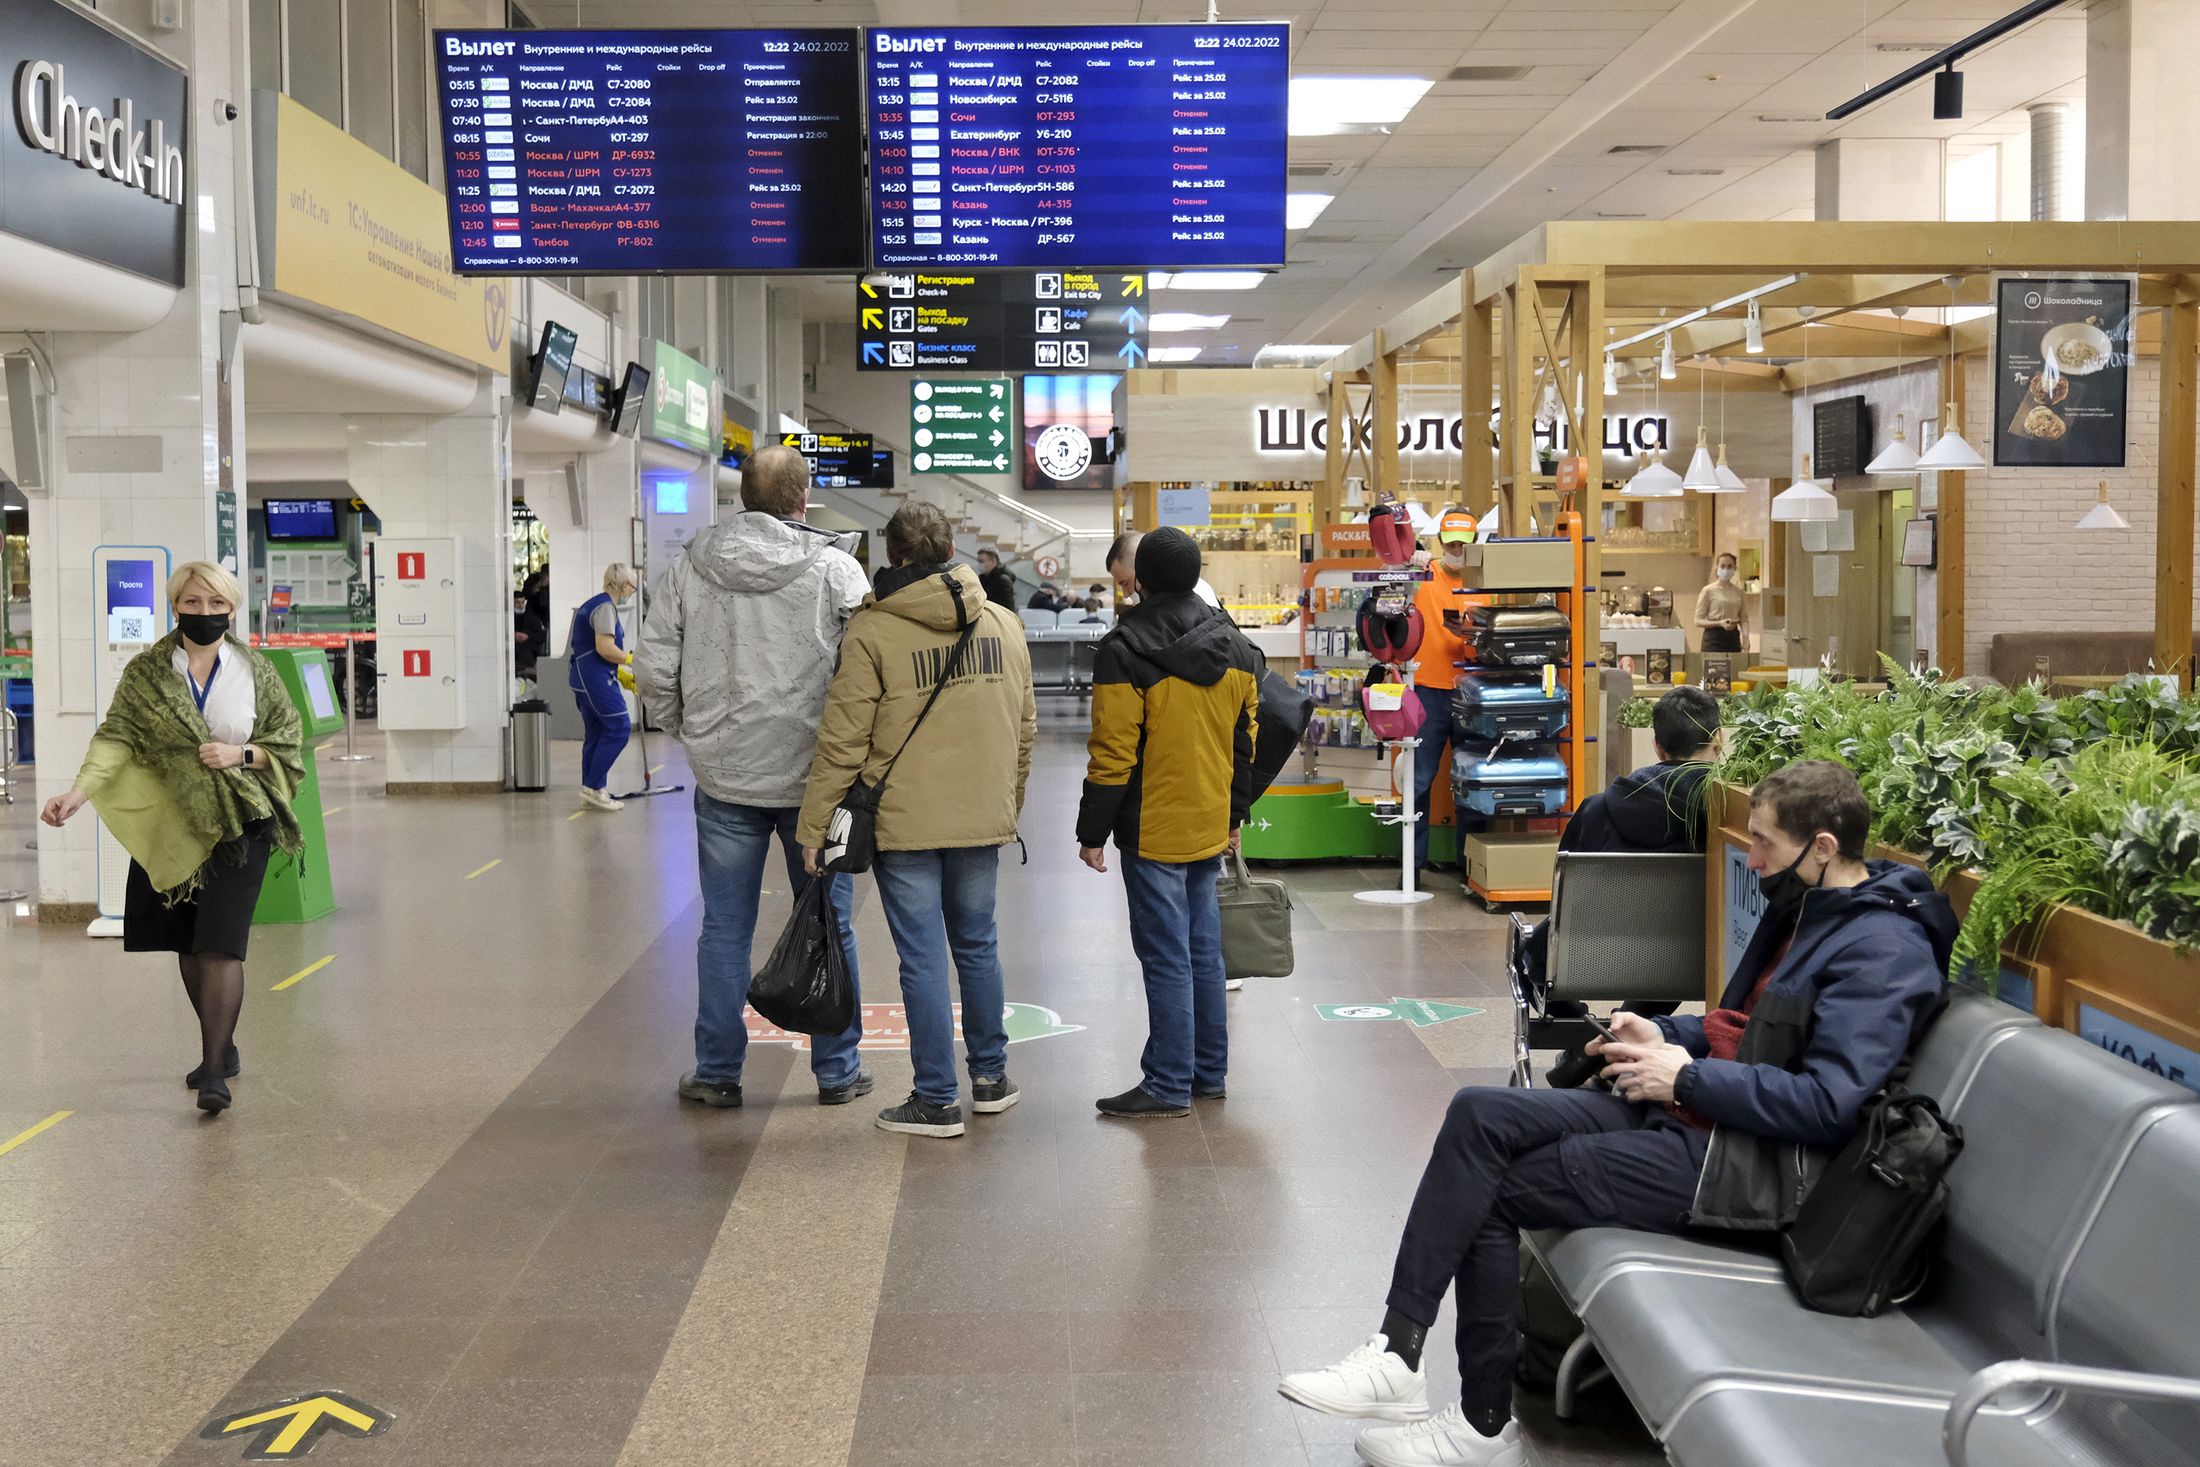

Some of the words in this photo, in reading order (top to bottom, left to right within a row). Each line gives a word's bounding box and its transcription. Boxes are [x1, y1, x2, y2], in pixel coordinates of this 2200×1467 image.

[446, 38, 515, 55] Вылет
[877, 34, 946, 52] Вылет
[955, 41, 1015, 52] Внутренние
[1026, 42, 1109, 51] международные
[1111, 40, 1142, 50] рейсы
[1194, 38, 1220, 47] 12:22
[1223, 37, 1279, 47] 24.02.2022
[524, 45, 584, 55] Внутренние
[596, 45, 678, 55] международные
[681, 44, 712, 54] рейсы
[764, 43, 789, 52] 12:22
[793, 43, 849, 52] 24.02.2022
[521, 80, 559, 89] Москва
[569, 80, 594, 90] ДМД
[608, 80, 651, 89] С7-2080
[745, 79, 800, 87] Отправляется
[877, 77, 900, 86] 13:15
[949, 77, 988, 86] Москва
[997, 76, 1022, 87] ДМД
[1036, 76, 1078, 85] С7-2082
[450, 81, 475, 90] 05:15
[451, 98, 479, 107] 07:30
[522, 98, 560, 107] Москва
[570, 98, 595, 108] ДМД
[609, 98, 651, 107] С7-2084
[878, 95, 903, 104] 13:30
[950, 95, 1017, 105] Новосибирск
[1036, 94, 1073, 103] С7-5116
[452, 116, 481, 125] 07:40
[609, 115, 648, 124] А4-403
[746, 114, 796, 122] Регистрация
[879, 113, 902, 122] 13:35
[951, 113, 975, 121] Сочи
[1037, 112, 1075, 120] ЮТ-293
[20, 60, 183, 205] Check-In
[879, 131, 904, 139] 13:45
[951, 130, 1021, 141] Екатеринбург
[1037, 129, 1071, 138] У6-210
[1204, 127, 1225, 135] 25.02
[454, 134, 480, 143] 08:15
[525, 134, 550, 142] Сочи
[611, 133, 649, 142] ЮТ-297
[747, 132, 797, 140] Регистрация
[456, 152, 480, 160] 10:55
[527, 152, 564, 160] Москва
[574, 151, 599, 159] ШРМ
[612, 151, 655, 160] ДР-6932
[880, 148, 907, 157] 14:00
[952, 148, 989, 156] Москва
[999, 148, 1020, 156] ВНК
[1037, 147, 1075, 156] ЮТ-576
[457, 169, 479, 178] 11:20
[528, 169, 565, 177] Москва
[575, 169, 600, 177] ШРМ
[613, 168, 651, 177] СУ-1273
[881, 166, 904, 174] 14:10
[952, 166, 989, 174] Москва
[999, 165, 1024, 174] ШРМ
[1037, 165, 1075, 173] СУ-1103
[881, 183, 906, 192] 14:20
[952, 183, 1038, 193] Санкт-Петербург
[1173, 180, 1191, 188] Рейс
[458, 186, 480, 195] 11:25
[529, 186, 566, 195] Москва
[576, 186, 601, 196] ДМД
[614, 186, 655, 194] С7-2072
[460, 204, 485, 212] 12:00
[531, 204, 558, 213] Воды
[882, 201, 907, 209] 14:30
[953, 201, 988, 209] Казань
[1038, 200, 1072, 208] А4-315
[461, 221, 484, 230] 12:10
[617, 220, 659, 229] ФВ-6316
[882, 218, 904, 227] 15:15
[953, 218, 982, 228] Курск
[992, 218, 1029, 226] Москва
[1036, 217, 1072, 226] РГ-396
[463, 238, 486, 247] 12:45
[533, 238, 569, 246] Тамбов
[618, 237, 653, 246] РГ-802
[883, 235, 906, 244] 15:25
[953, 235, 989, 243] Казань
[1038, 234, 1075, 244] ДР-567
[917, 275, 975, 286] Регистрация
[1064, 273, 1094, 283] Выход
[1072, 283, 1100, 291] город
[917, 288, 948, 296] Check-in
[1087, 292, 1102, 301] City
[2043, 297, 2102, 306] Шоколадница
[918, 307, 947, 317] Выход
[1064, 309, 1088, 319] Кафе
[931, 317, 968, 326] посадку
[1064, 322, 1081, 330] Cafe
[917, 325, 938, 333] Gates
[918, 343, 949, 351] Бизнес
[951, 344, 976, 352] класс
[918, 356, 948, 364] Business
[949, 356, 968, 364] Class
[1332, 531, 1371, 541] PACK&FL
[119, 581, 143, 589] Просто
